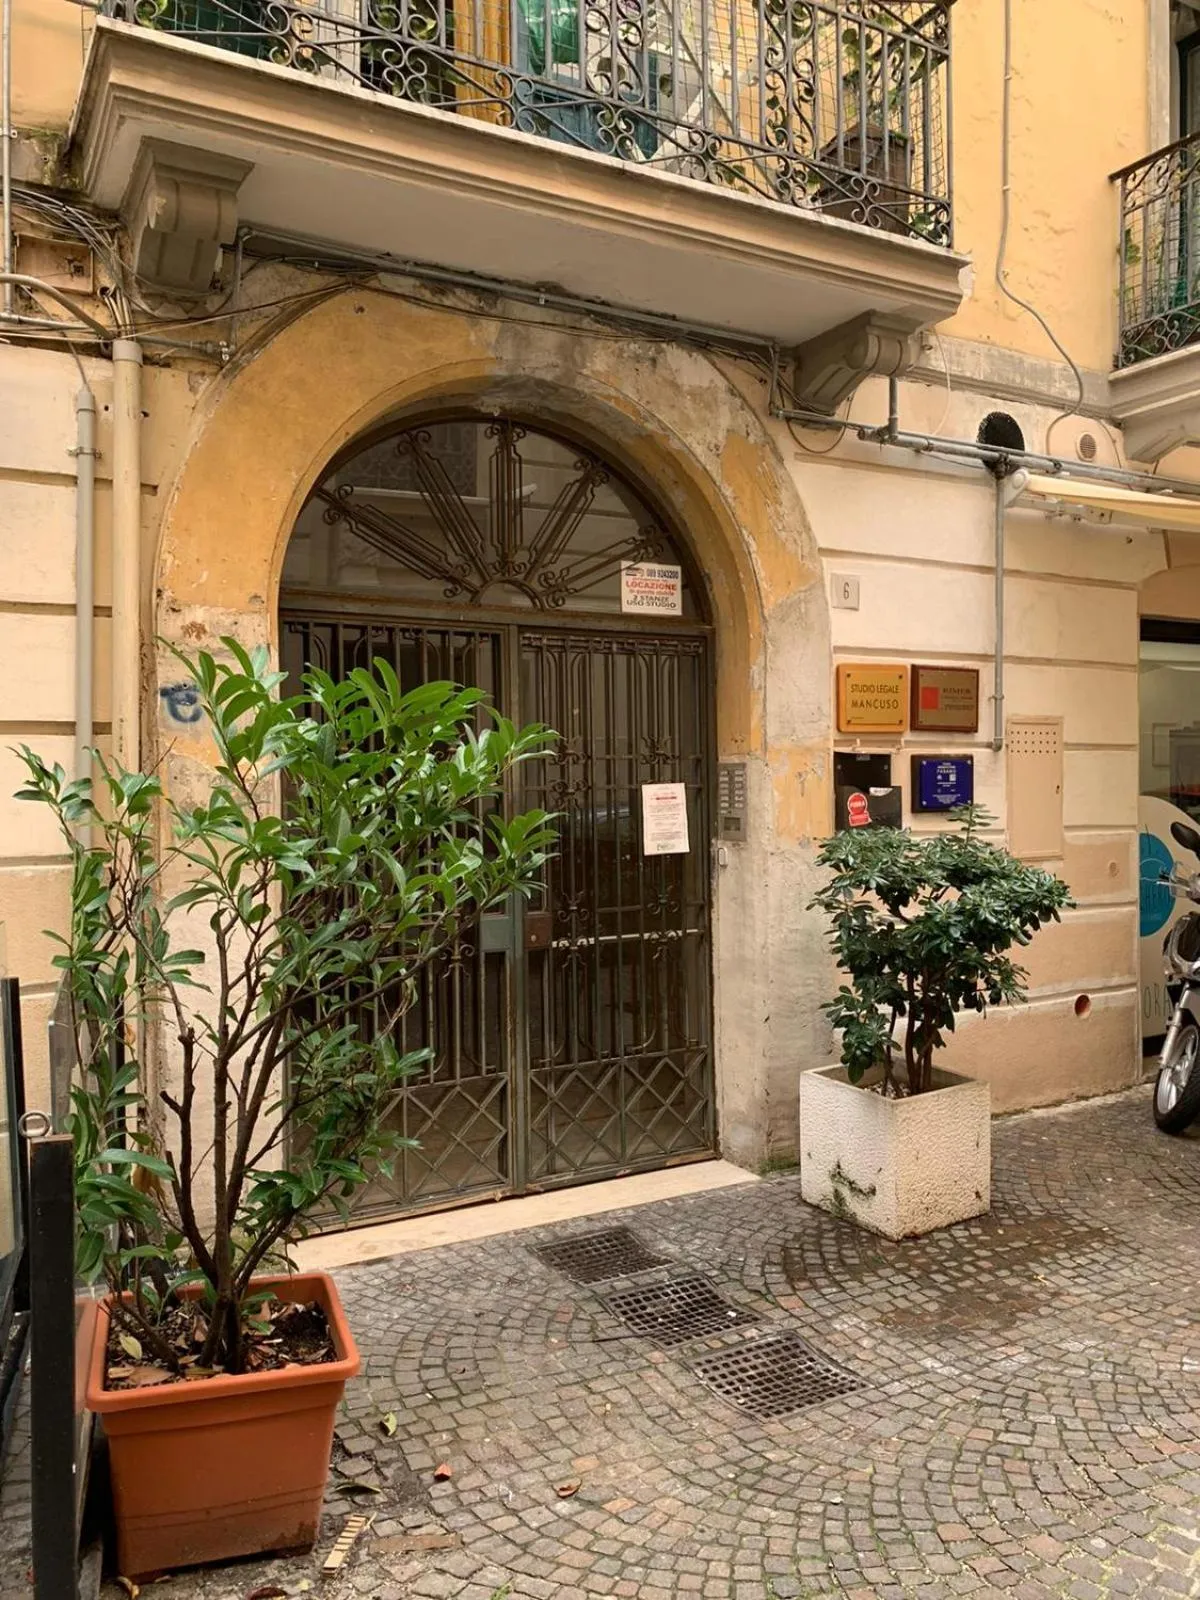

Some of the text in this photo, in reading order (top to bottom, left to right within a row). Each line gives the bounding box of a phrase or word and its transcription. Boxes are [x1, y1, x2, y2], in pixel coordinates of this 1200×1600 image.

[626, 580, 677, 591] LOCAZIONE
[843, 581, 850, 601] 6
[850, 683, 900, 694] STUDIO LEGALE
[850, 699, 899, 709] MANCUSO
